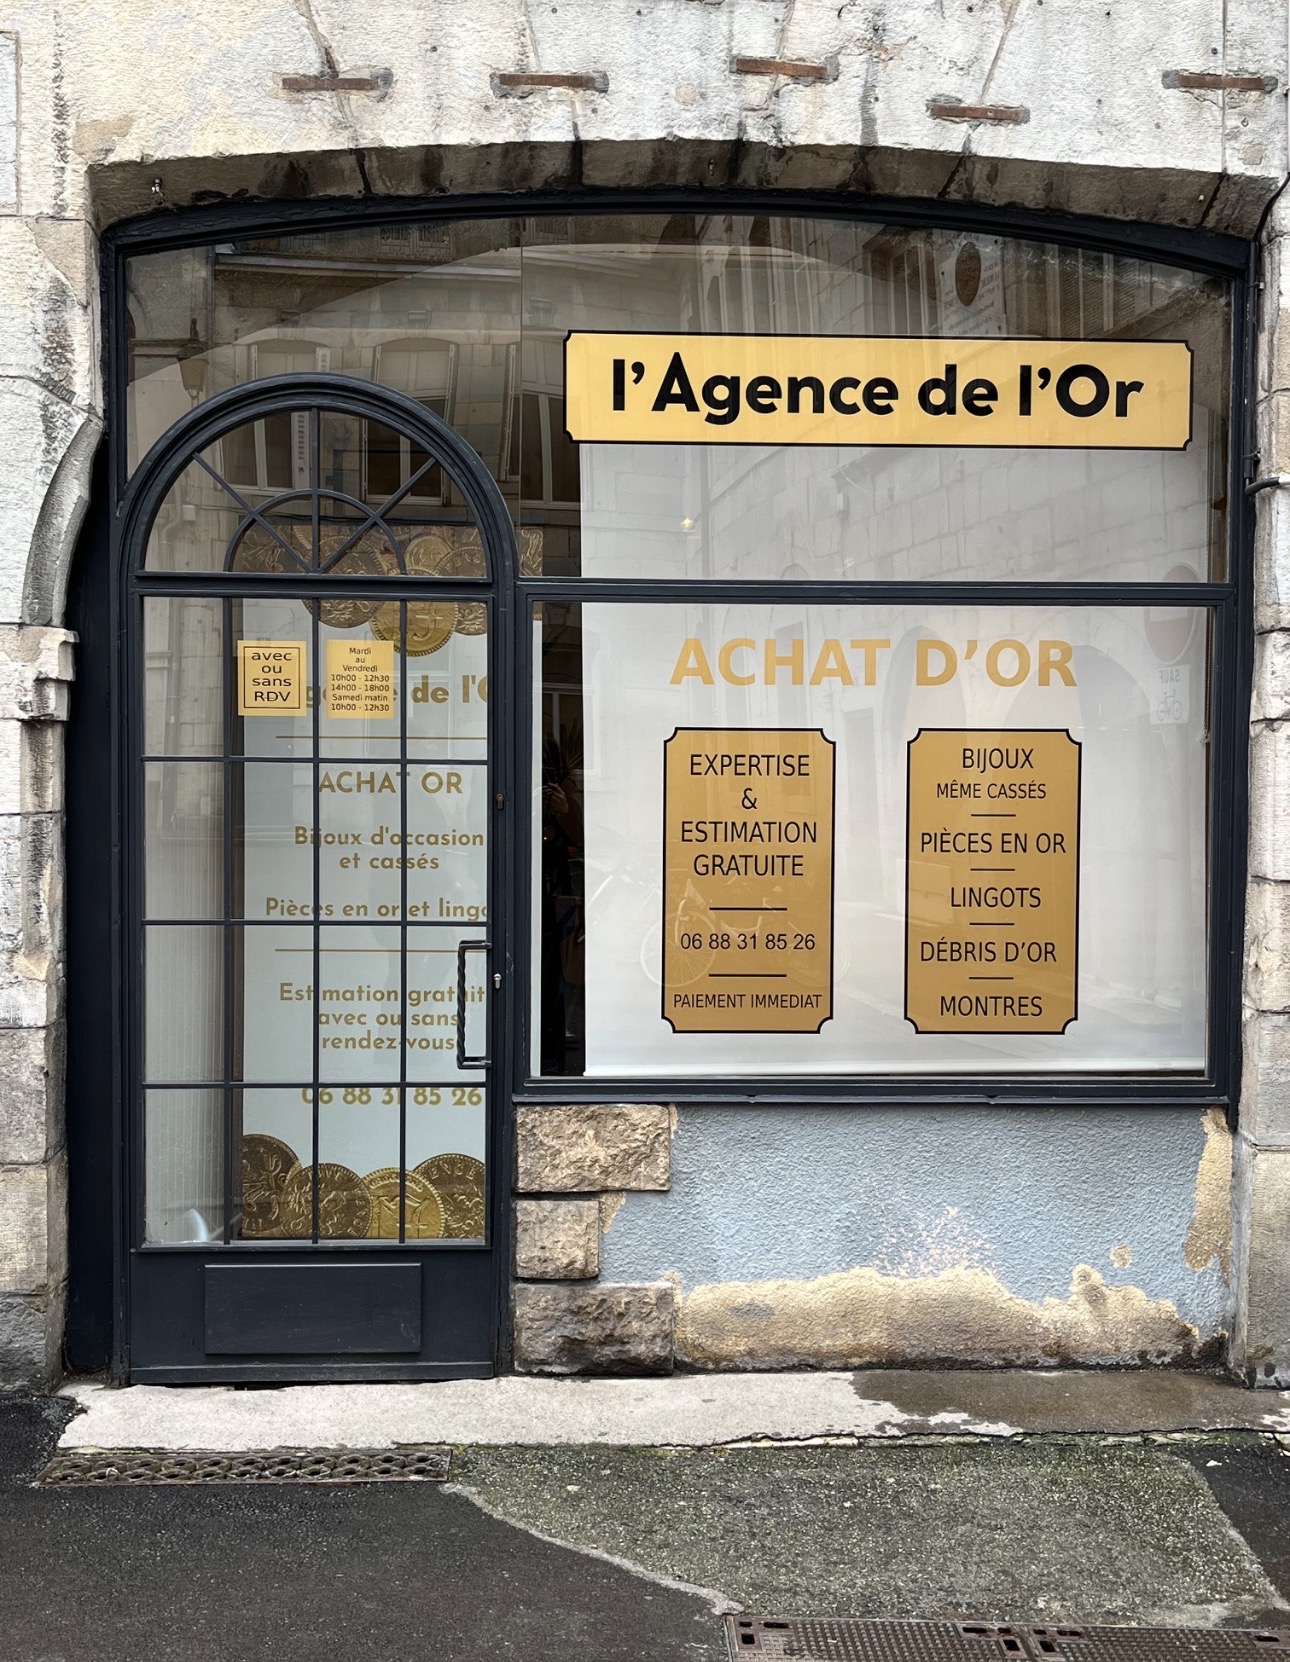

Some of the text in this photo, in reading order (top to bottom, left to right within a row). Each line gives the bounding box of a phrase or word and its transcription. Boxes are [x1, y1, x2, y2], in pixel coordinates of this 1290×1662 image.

[613, 352, 1144, 425] l’Agence de l’Or
[251, 651, 293, 662] avec
[349, 647, 372, 655] Mardi
[261, 664, 283, 675] ou
[342, 664, 379, 673] Vendredi
[670, 638, 1077, 687] ACHAT D’OR
[251, 676, 293, 688] sans
[330, 673, 357, 682] 10h00
[363, 673, 391, 682] 12h30
[253, 691, 292, 702] RDV
[330, 683, 357, 692] 14h00
[363, 683, 391, 692] 18h00
[411, 675, 449, 703] de
[331, 693, 364, 702] Samedi
[364, 693, 389, 702] matin
[330, 703, 357, 712] 10h00
[363, 703, 391, 712] 12h30
[691, 754, 809, 776] EXPERTISE
[963, 748, 1033, 773] BIJOUX
[421, 772, 463, 793] OR
[937, 779, 1046, 799] MÊME CASSÉS
[742, 788, 757, 809] &
[682, 821, 816, 843] ESTIMATION
[922, 828, 1066, 853] PIÈCES EN OR
[339, 853, 439, 869] et cassés
[694, 854, 803, 876] GRATUITE
[951, 887, 1041, 908] LINGOTS
[342, 904, 368, 916] en
[377, 904, 399, 917] or
[408, 901, 429, 917] et
[681, 933, 815, 950] 06 88 31 85 26
[921, 937, 996, 962] DÉBRIS
[280, 982, 398, 1002] Estmation
[674, 994, 822, 1008] PAIEMENT IMMEDIAT
[941, 996, 1042, 1016] MONTRES
[318, 1013, 458, 1026] avec ou sans
[343, 1087, 372, 1105] 88
[414, 1087, 441, 1105] 85
[452, 1087, 482, 1106] 26
